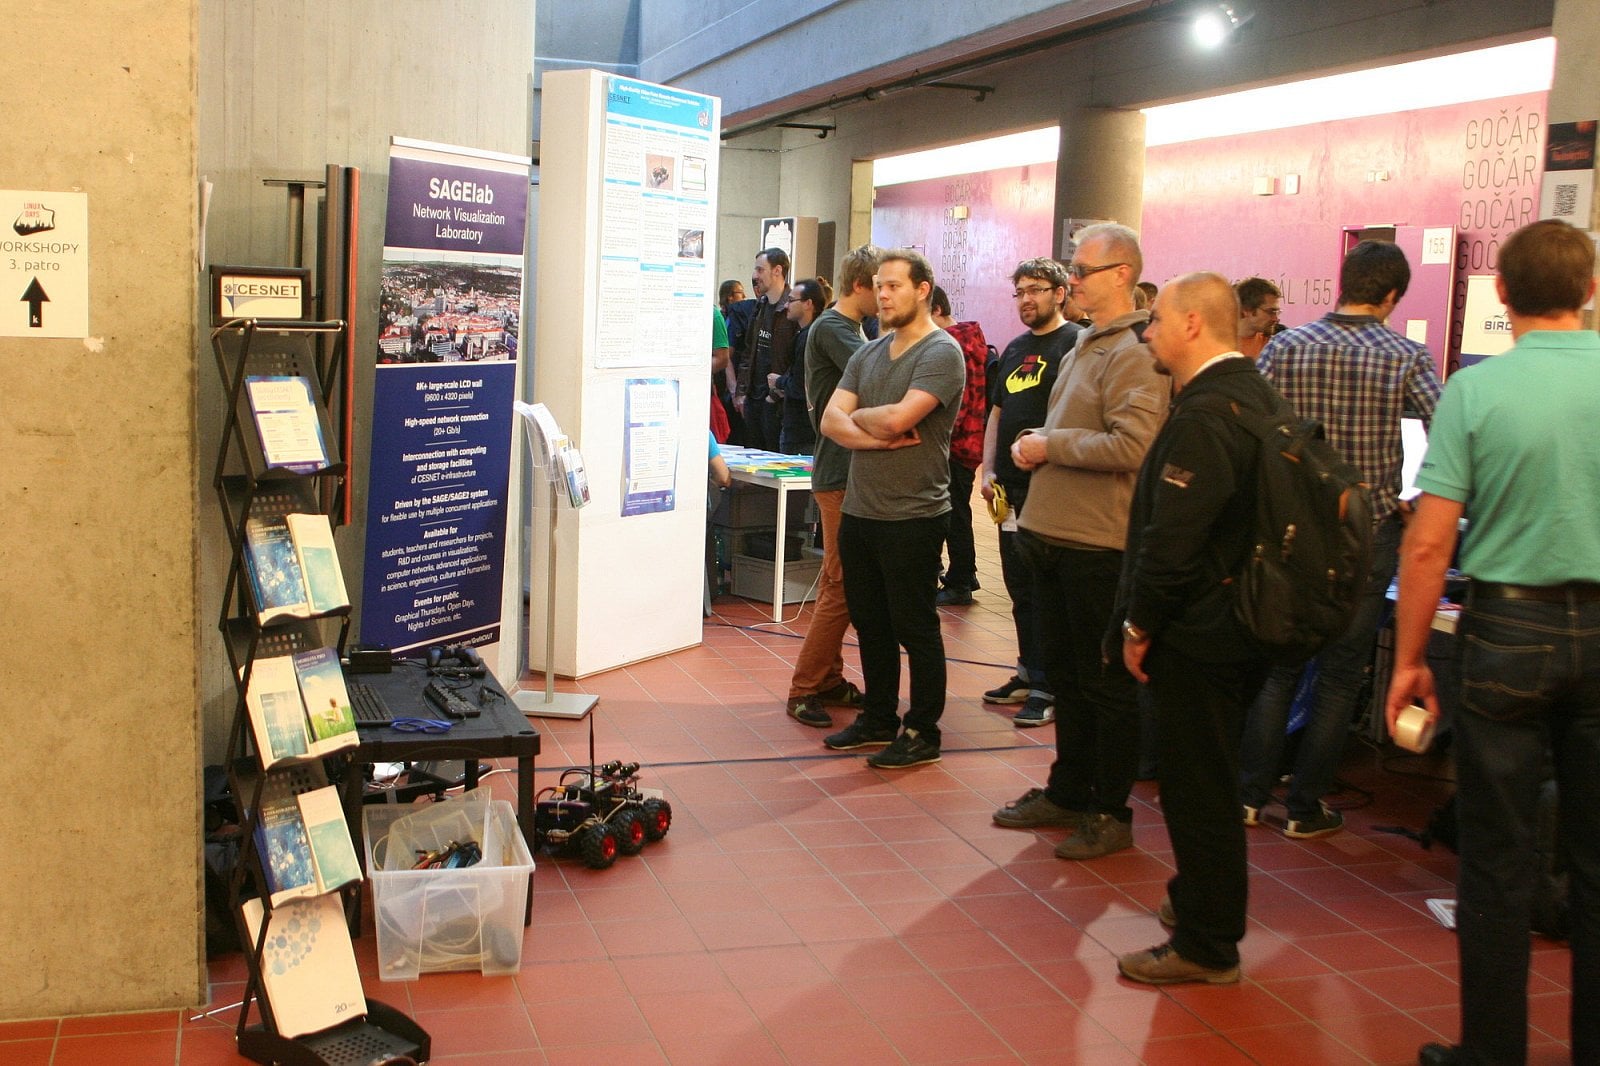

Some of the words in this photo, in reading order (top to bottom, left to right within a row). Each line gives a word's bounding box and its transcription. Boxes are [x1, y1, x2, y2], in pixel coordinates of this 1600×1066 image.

[1465, 106, 1540, 150] GOČÁR
[1463, 148, 1536, 190] GOČÁR
[428, 177, 494, 204] SAGElab
[24, 202, 41, 210] LINUX
[25, 210, 40, 218] DAYS
[413, 203, 451, 220] Network
[454, 207, 505, 225] Visualization
[1460, 190, 1533, 230] GOČÁR
[436, 224, 483, 244] Laboratory
[943, 226, 968, 250] GOČÁR
[1428, 237, 1445, 254] 155
[9, 258, 20, 270] 3.
[24, 260, 60, 272] patro
[942, 250, 967, 272] GOČÁR
[238, 284, 300, 296] CESNET
[1304, 279, 1332, 306] 155
[416, 382, 428, 391] 8K+
[428, 381, 458, 391] large-scale
[460, 380, 471, 390] LCD
[472, 380, 483, 388] wall
[404, 416, 436, 428] High-speed
[437, 415, 459, 424] network
[460, 412, 488, 422] connection
[402, 451, 445, 462] Interconnection
[446, 448, 458, 457] with
[459, 446, 487, 457] computing
[416, 463, 428, 472] and
[428, 462, 449, 471] storage
[450, 458, 472, 468] facilities
[411, 476, 417, 484] of
[418, 472, 440, 484] CESNET
[441, 470, 476, 480] e-infrastructure
[394, 500, 413, 510] Driven
[414, 498, 421, 508] by
[422, 496, 431, 505] the
[470, 489, 488, 500] system
[381, 514, 389, 524] for
[390, 512, 407, 522] flexible
[418, 510, 425, 518] by
[426, 506, 444, 518] multiple
[445, 503, 471, 513] concurrent
[424, 528, 448, 539] Available
[449, 526, 458, 535] for
[406, 544, 428, 554] teachers
[428, 541, 438, 549] and
[438, 536, 466, 547] researchers
[386, 569, 411, 580] computer
[436, 559, 460, 570] advanced
[460, 554, 488, 566] applications
[411, 555, 421, 564] and
[422, 553, 441, 562] courses
[439, 570, 456, 580] culture
[457, 568, 467, 577] and
[414, 596, 432, 608] Events
[434, 594, 442, 602] for
[442, 591, 460, 602] public
[394, 610, 420, 623] Graphical
[447, 602, 461, 612] Open
[408, 620, 424, 632] Nights
[425, 618, 430, 626] of
